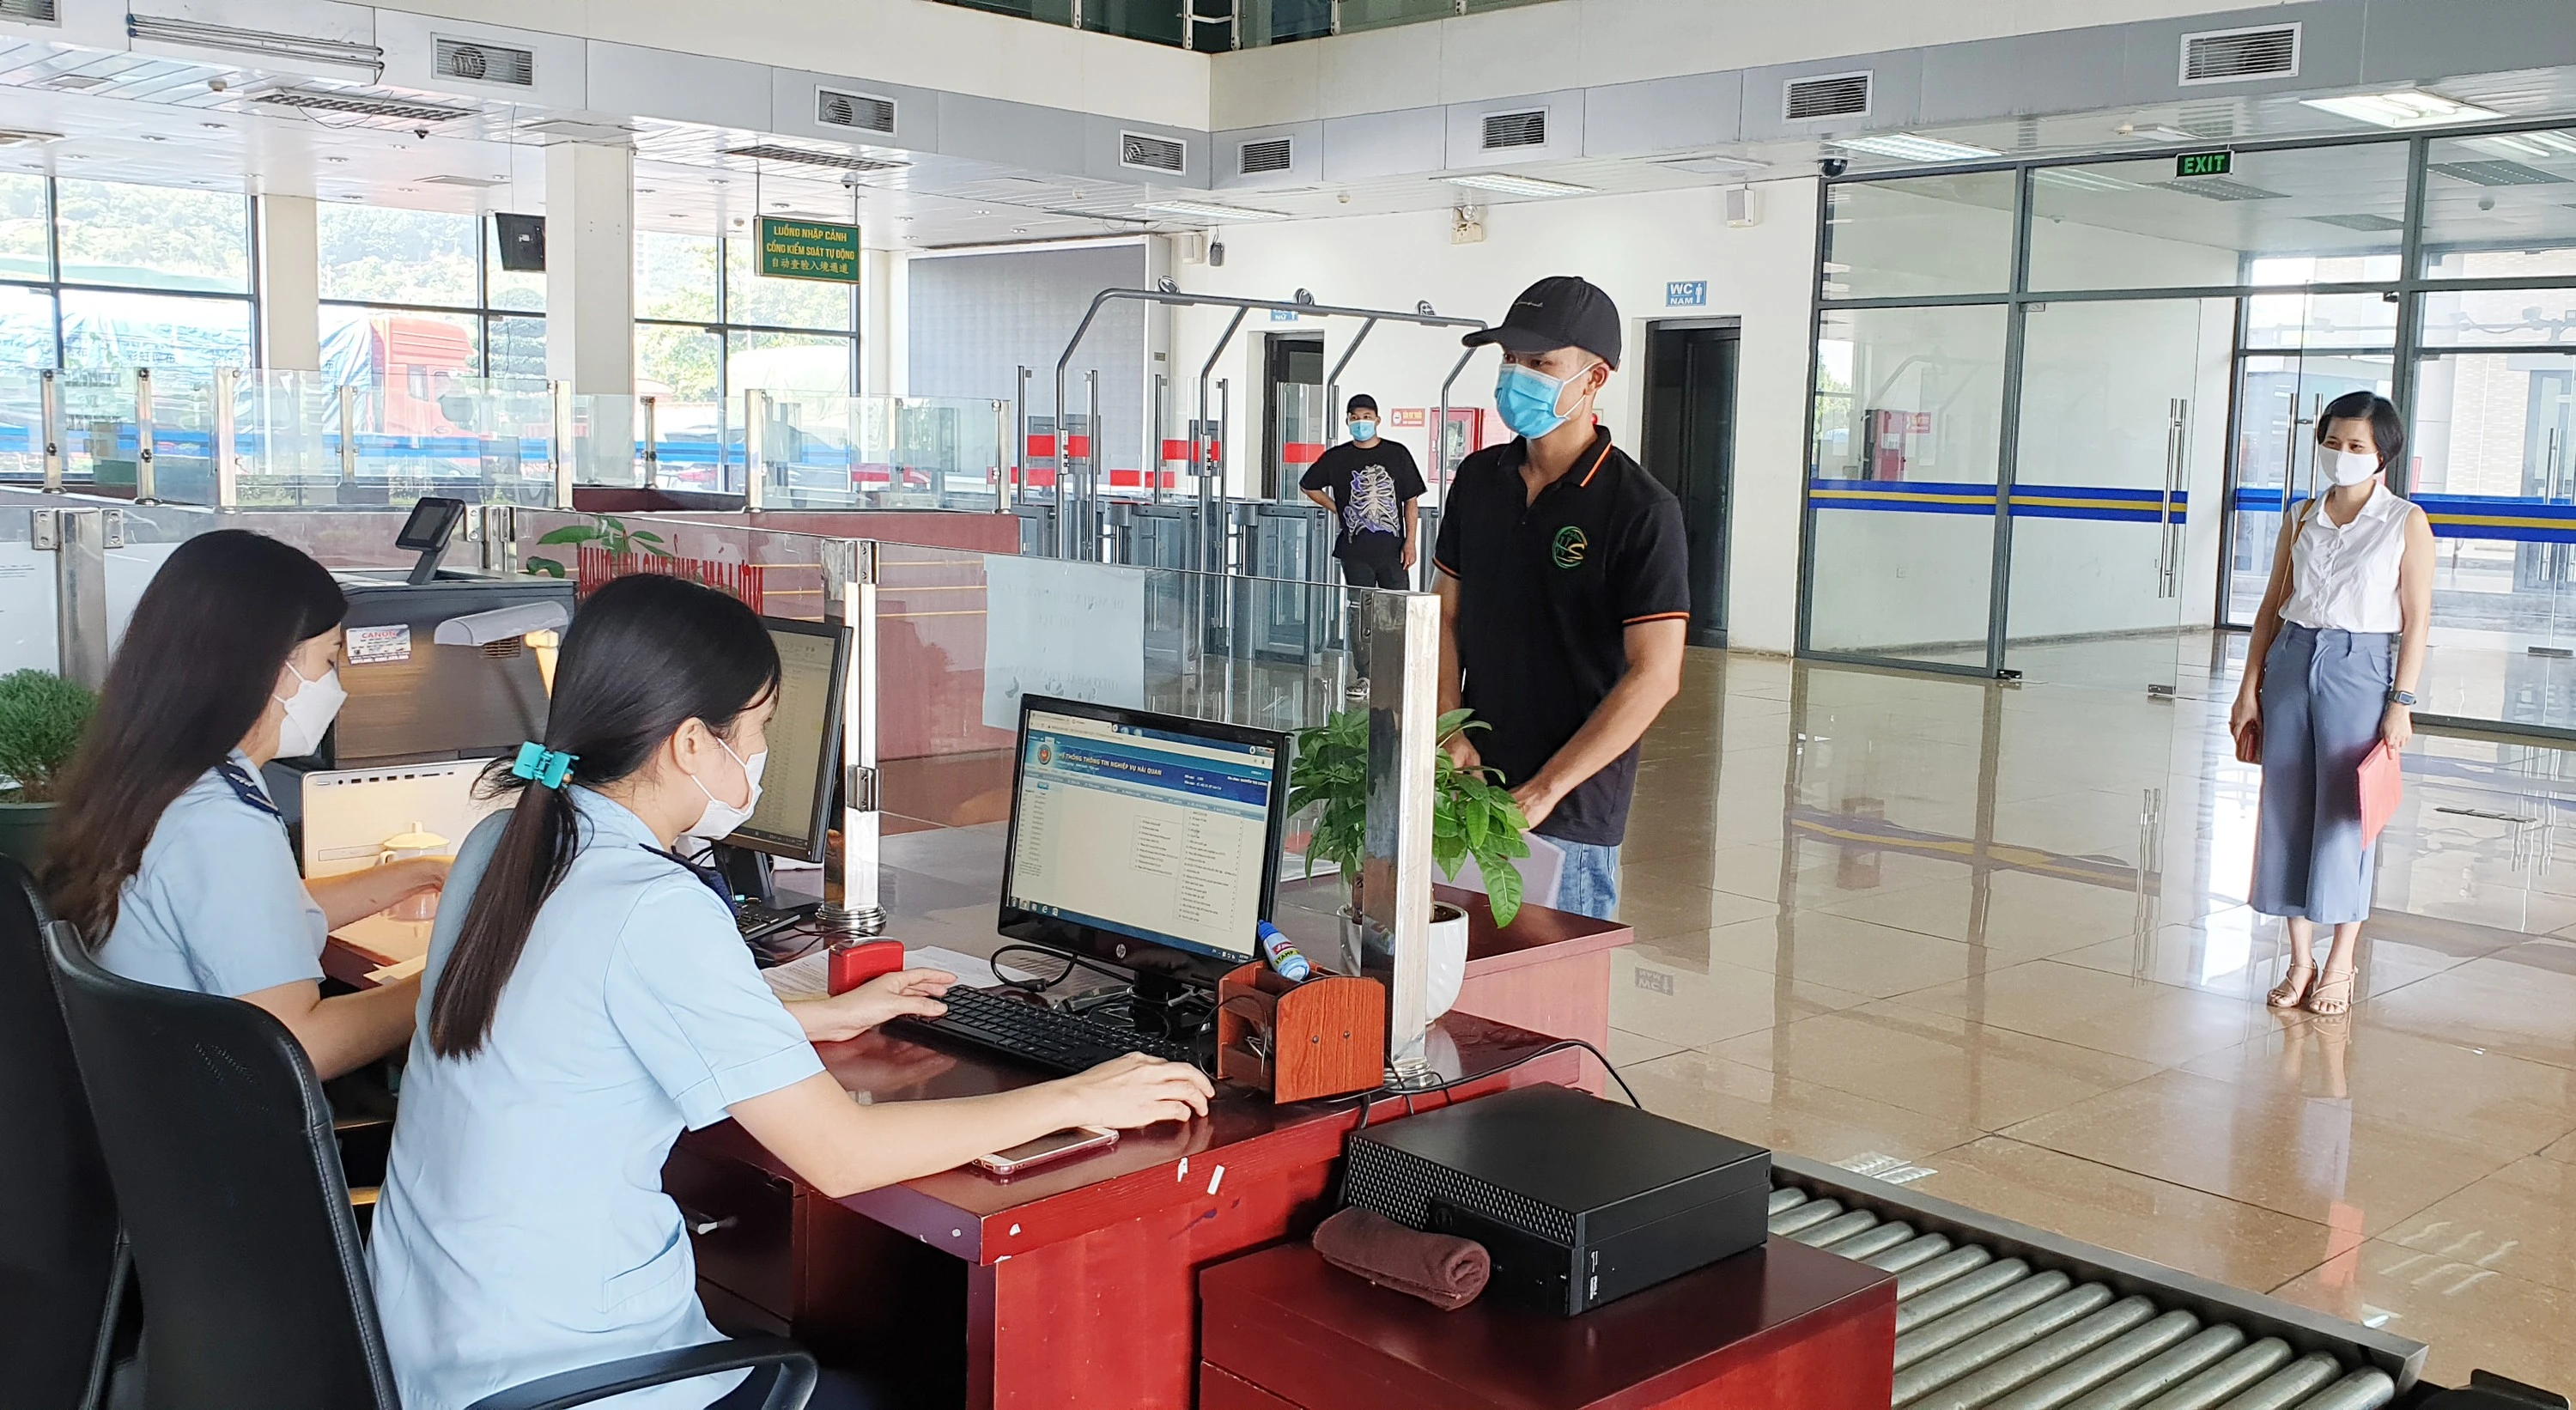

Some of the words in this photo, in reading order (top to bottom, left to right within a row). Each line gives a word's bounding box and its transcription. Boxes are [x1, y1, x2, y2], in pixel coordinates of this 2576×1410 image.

[2184, 155, 2225, 174] EXIT
[801, 228, 824, 241] NHẬP
[825, 228, 848, 242] CẢNH
[767, 240, 786, 253] CỔNG
[787, 241, 805, 255] KIỂM
[806, 246, 824, 257] SOÁT
[1670, 283, 1693, 295] WC
[1146, 767, 1163, 776] QUAN
